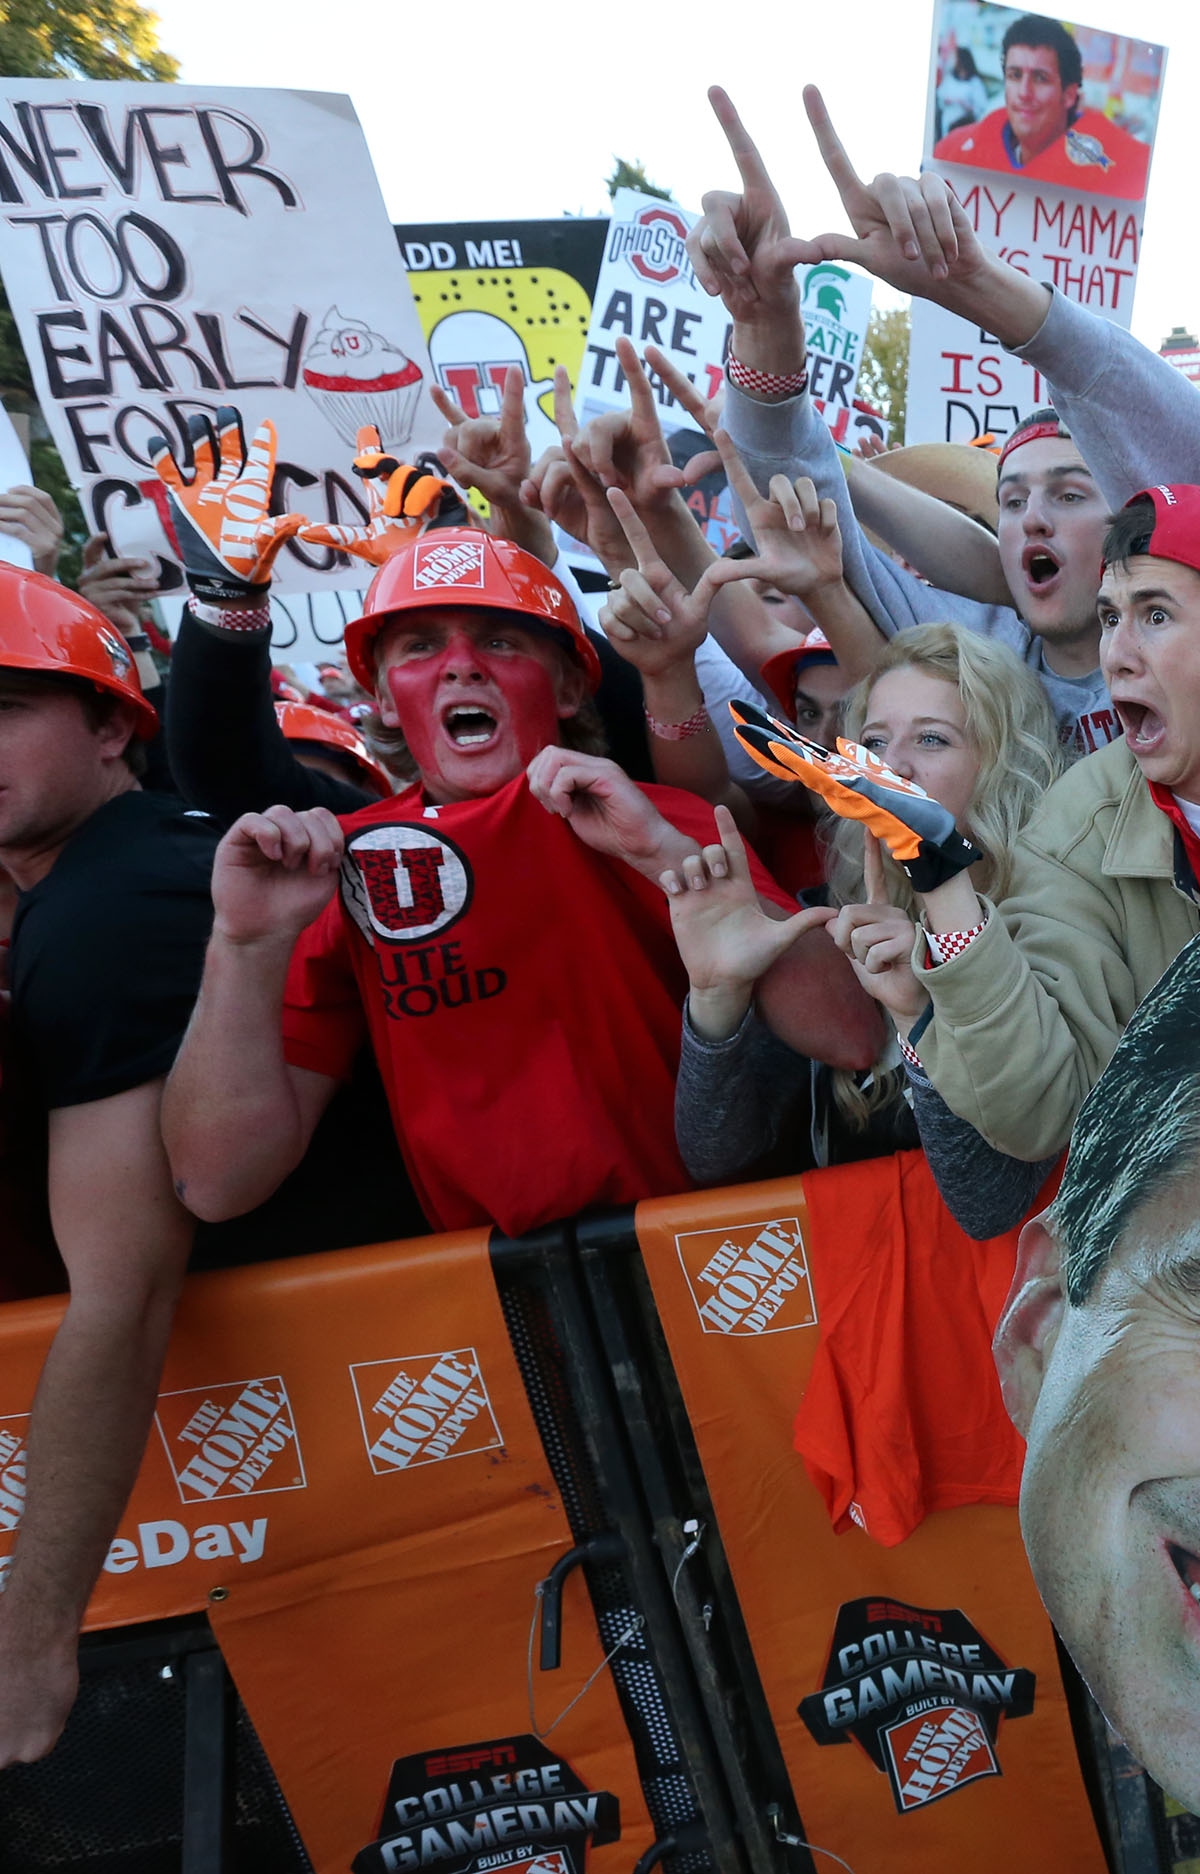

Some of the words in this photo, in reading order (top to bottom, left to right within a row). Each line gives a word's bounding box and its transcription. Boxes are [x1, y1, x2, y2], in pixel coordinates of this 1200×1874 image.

[0, 101, 299, 217] NEVER
[7, 210, 188, 301] TOO
[401, 242, 456, 270] DD
[464, 239, 523, 268] ME!
[608, 226, 651, 263] OHIO
[1033, 196, 1139, 265] MAMA
[1043, 254, 1134, 310] THAT
[600, 289, 702, 356] ARE
[36, 303, 309, 399] EARLY
[940, 352, 1003, 398] IS
[415, 541, 482, 587] HOME
[421, 543, 450, 564] THE
[440, 556, 482, 585] DEPOT
[377, 942, 466, 987] UTE
[697, 1239, 744, 1287] THE
[700, 1221, 801, 1334] HOME
[742, 1256, 808, 1333] DEPOT
[370, 1352, 480, 1468] HOME
[372, 1370, 419, 1418] THE
[177, 1399, 226, 1446] THE
[177, 1380, 289, 1499] HOME
[422, 1387, 489, 1459] DEPOT
[229, 1416, 297, 1493] DEPOT
[866, 1603, 943, 1633] ESPN
[838, 1630, 985, 1677] COLLEGE
[823, 1659, 1016, 1729] GAMEDAY
[906, 1696, 938, 1717] BUILT
[940, 1696, 955, 1706] BY
[424, 1746, 517, 1778] ESPN
[900, 1707, 979, 1802] HOME
[903, 1721, 939, 1764] THE
[938, 1730, 990, 1788] DEPOT
[394, 1764, 566, 1828] COLLEGE
[379, 1797, 600, 1874] GAMEDAY
[477, 1849, 513, 1871] BUILT
[516, 1844, 534, 1859] BY
